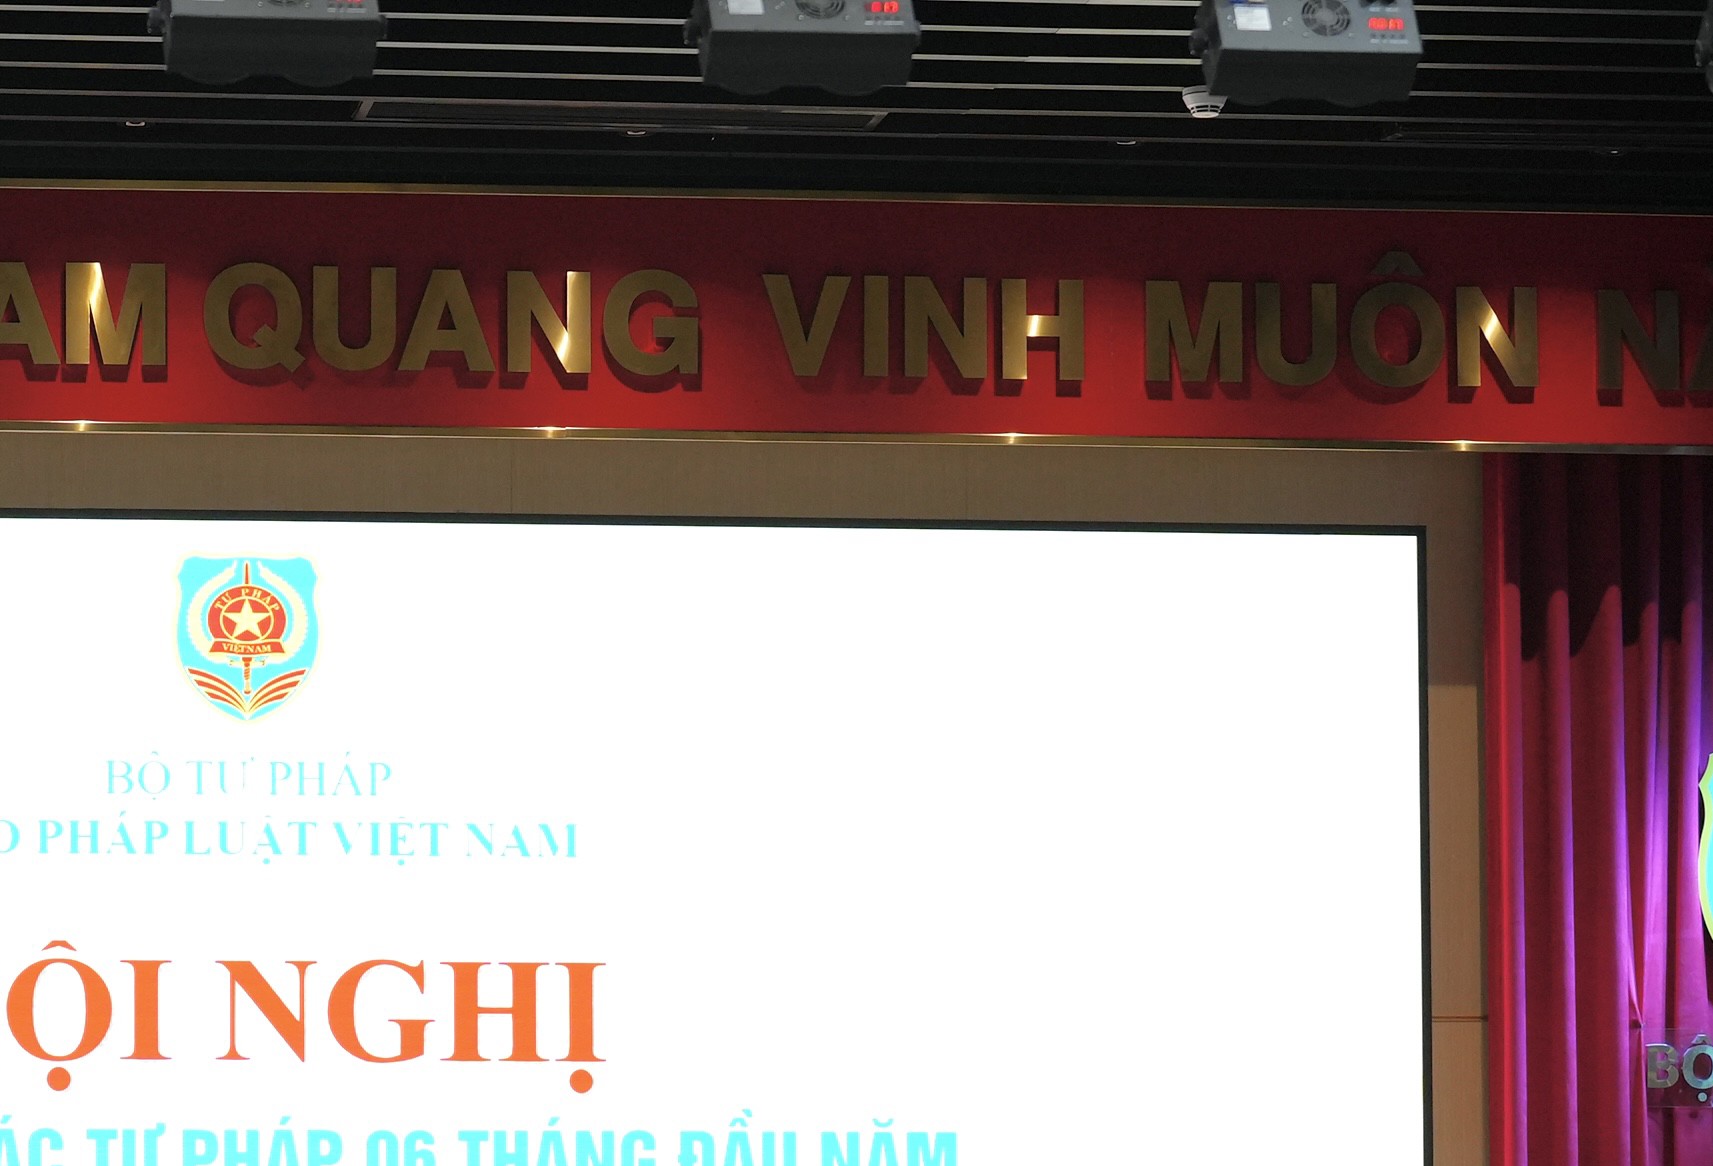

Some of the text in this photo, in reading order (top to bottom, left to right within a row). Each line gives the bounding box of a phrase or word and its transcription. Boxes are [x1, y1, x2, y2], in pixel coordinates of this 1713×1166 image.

[203, 262, 699, 375] QUANG
[763, 273, 1084, 381] VINH
[1145, 252, 1538, 389] MUÔN
[106, 751, 392, 800] BỘ TƯ PHÁP
[38, 810, 170, 856] PHÁP
[184, 816, 319, 865] LUẬT
[332, 816, 449, 866] VIỆT
[466, 822, 577, 858] NAM
[215, 959, 606, 1094] NGHỊ
[1645, 1034, 1713, 1102] BỘ
